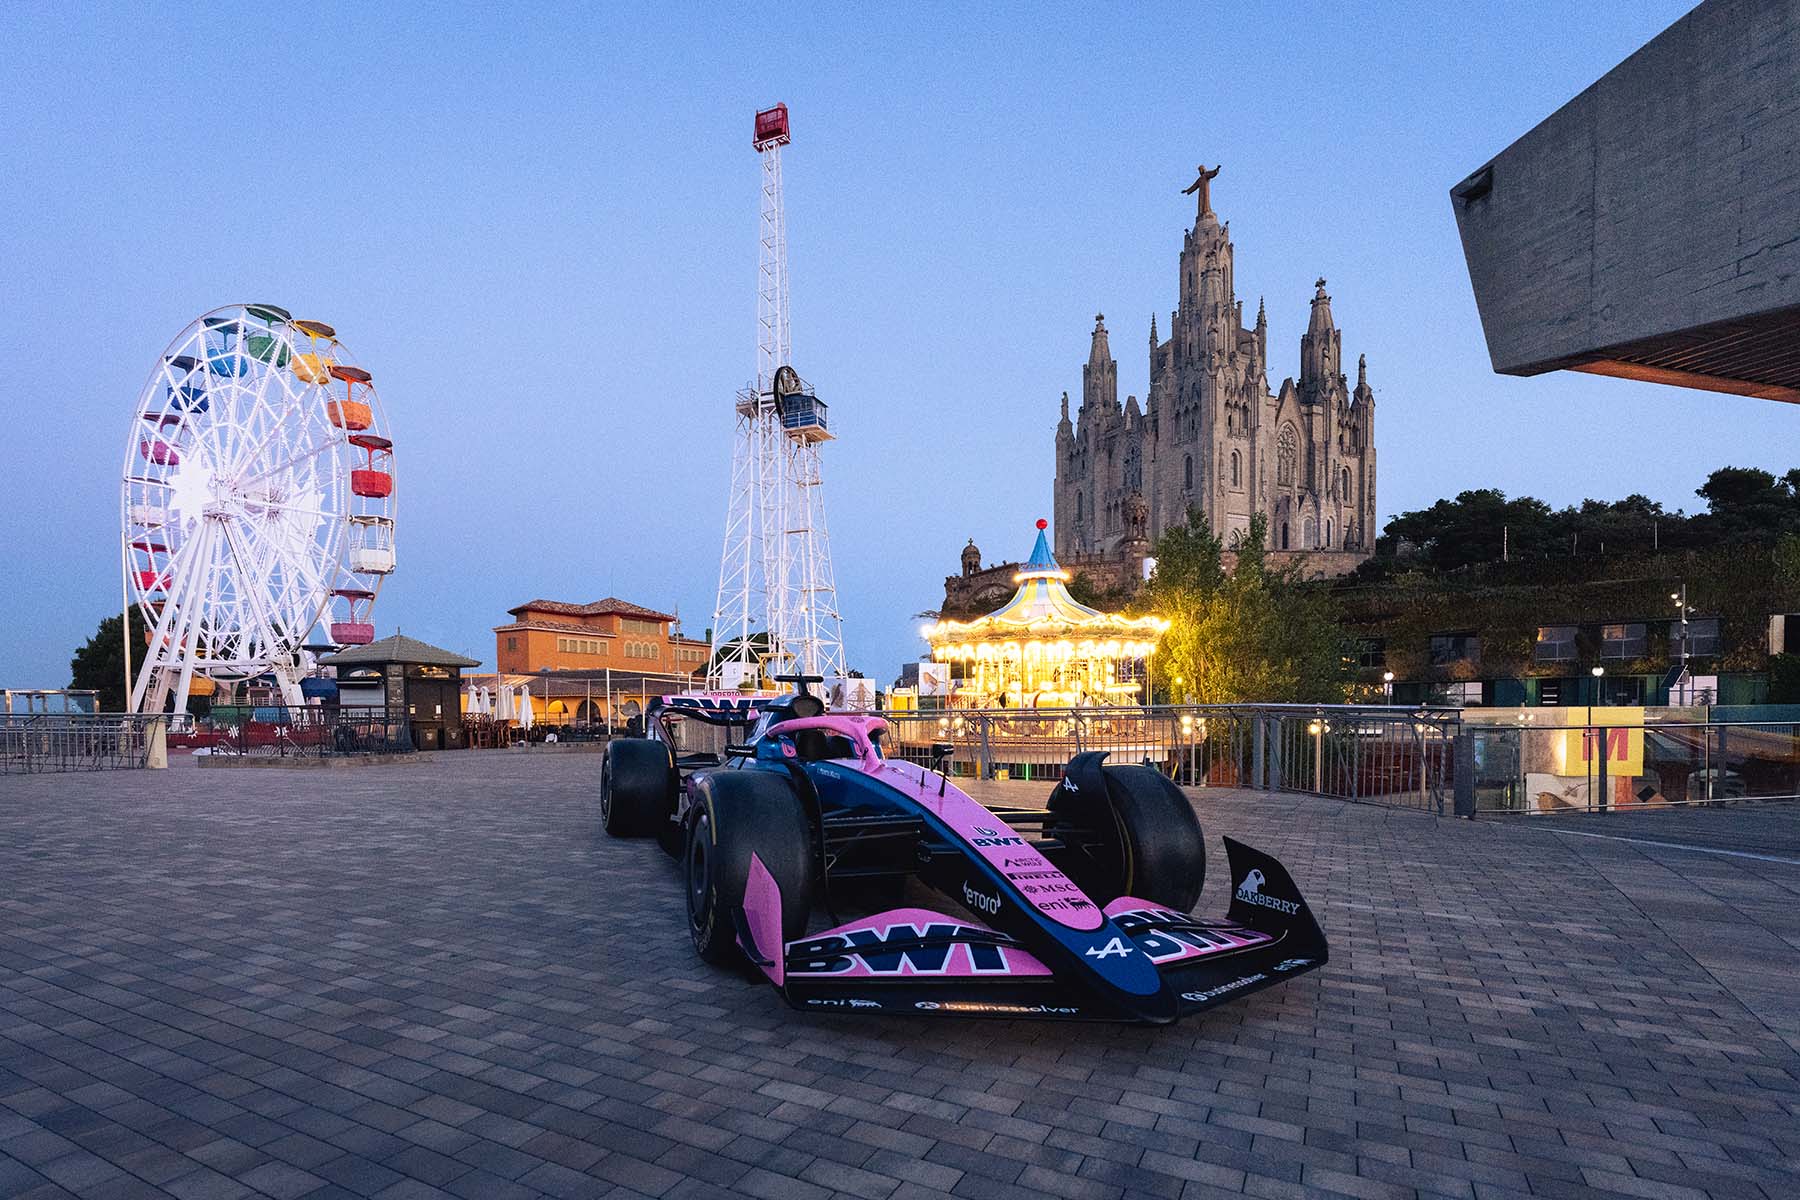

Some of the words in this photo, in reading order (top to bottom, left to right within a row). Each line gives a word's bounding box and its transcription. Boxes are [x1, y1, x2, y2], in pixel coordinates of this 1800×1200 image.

[971, 837, 1023, 847] BWT
[1006, 871, 1065, 880] PIRELLI
[1039, 884, 1079, 894] MSC
[1038, 898, 1069, 911] eni
[1236, 888, 1300, 915] OAKBERRY
[785, 922, 1011, 977] BWT
[807, 998, 848, 1006] eni
[944, 1002, 1080, 1014] businessolver
